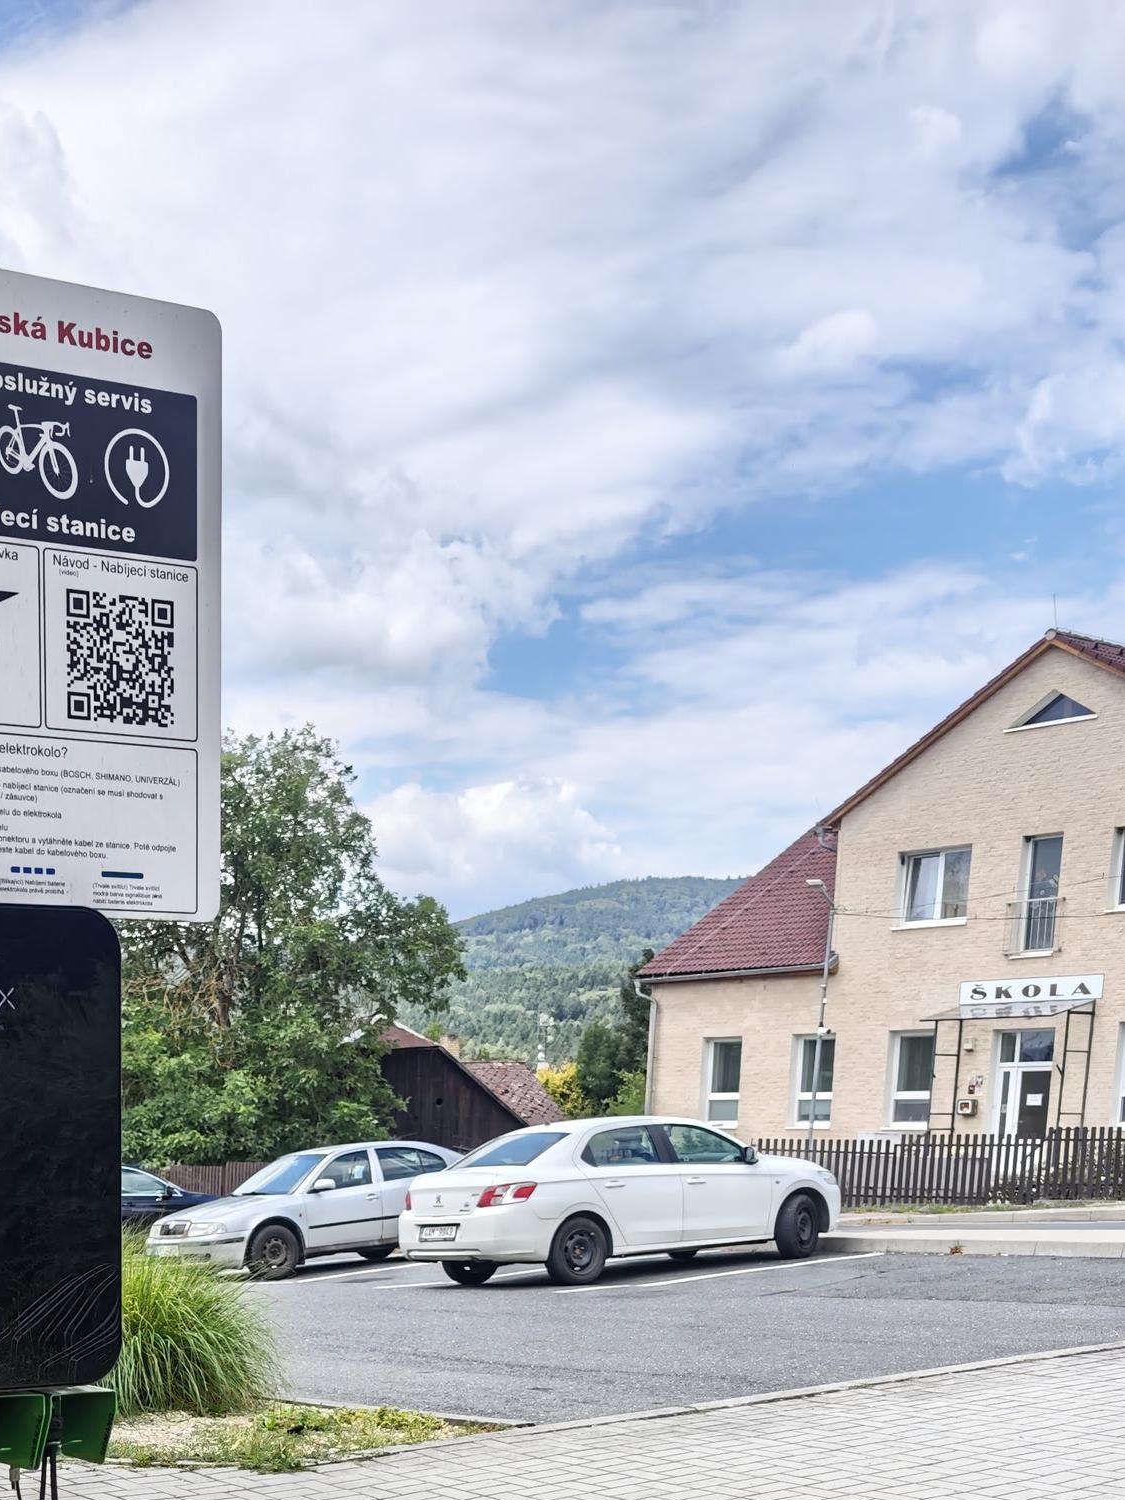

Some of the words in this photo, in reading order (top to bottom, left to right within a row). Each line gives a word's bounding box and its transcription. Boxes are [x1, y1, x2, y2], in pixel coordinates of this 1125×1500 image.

[58, 321, 153, 359] Kubice
[84, 389, 153, 414] servis
[46, 514, 136, 543] stanice
[52, 554, 90, 570] Návod
[101, 560, 147, 578] Nabíjecí
[149, 567, 189, 582] stanice
[59, 569, 79, 578] (video)
[41, 767, 59, 777] boxu
[135, 775, 180, 788] UNIVERZÁL)
[2, 781, 31, 792] nabíjecí
[33, 784, 59, 793] stanice
[60, 786, 96, 797] (označení
[126, 790, 158, 801] shodovat
[5, 792, 38, 803] zásuvce)
[12, 808, 21, 817] do
[23, 809, 62, 819] elektrokola
[14, 846, 35, 855] kabel
[36, 847, 46, 856] do
[47, 848, 88, 859] kabelového
[38, 837, 73, 847] vytáhněte
[74, 839, 94, 848] kabel
[151, 844, 177, 854] odpojte
[970, 982, 1092, 1001] ŠKOLA
